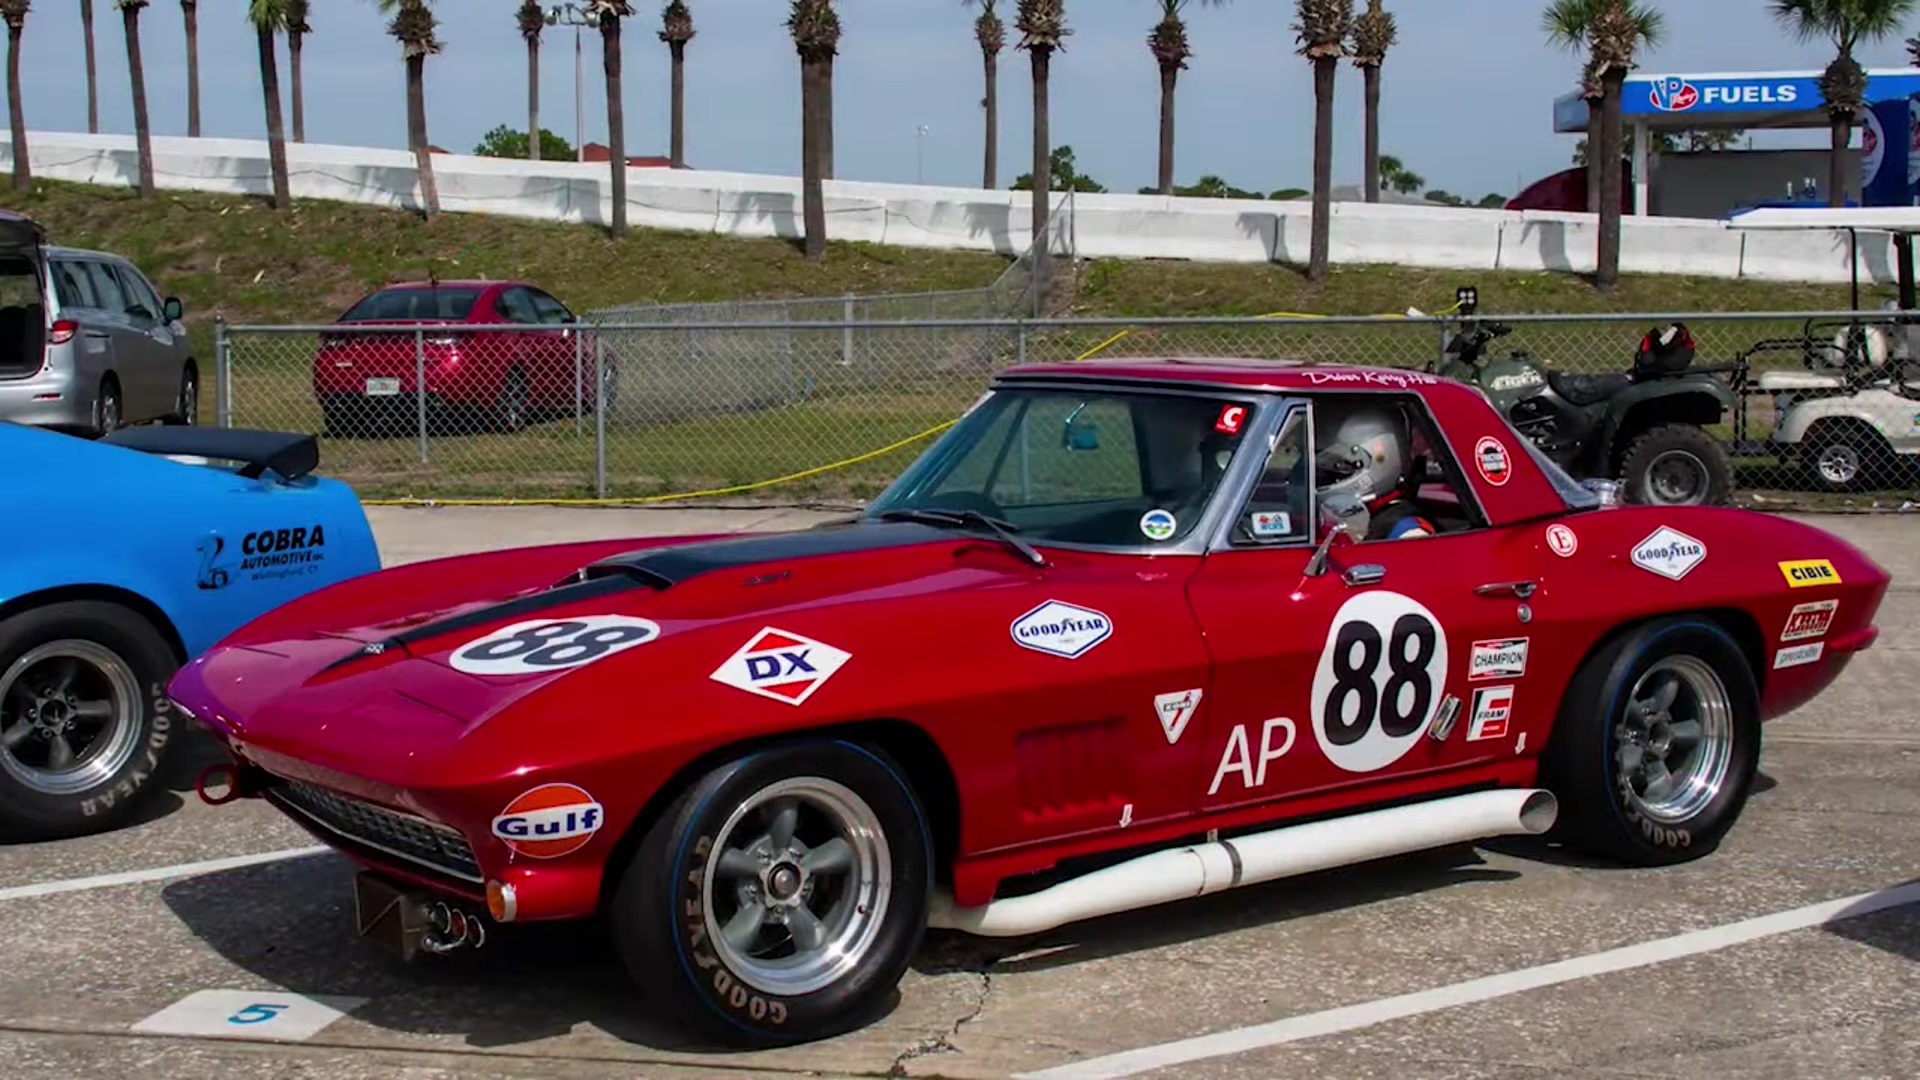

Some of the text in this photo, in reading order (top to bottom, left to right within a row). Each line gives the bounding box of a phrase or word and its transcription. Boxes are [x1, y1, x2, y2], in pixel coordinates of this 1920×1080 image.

[1703, 85, 1798, 104] FUELS
[1223, 407, 1243, 428] C
[242, 525, 325, 555] COBRA
[1553, 531, 1571, 549] E
[240, 551, 312, 570] AUTOMOTIVE
[1637, 542, 1701, 561] GOODYEAR
[1019, 618, 1104, 638] GOODYEAR
[460, 621, 651, 666] 88
[744, 649, 817, 682] DX
[1474, 651, 1523, 667] CHAMPION
[1323, 612, 1437, 747] 88
[1478, 709, 1506, 720] FRAM
[1207, 716, 1297, 796] AP
[497, 808, 598, 836] Gulf
[227, 1004, 290, 1024] 5
